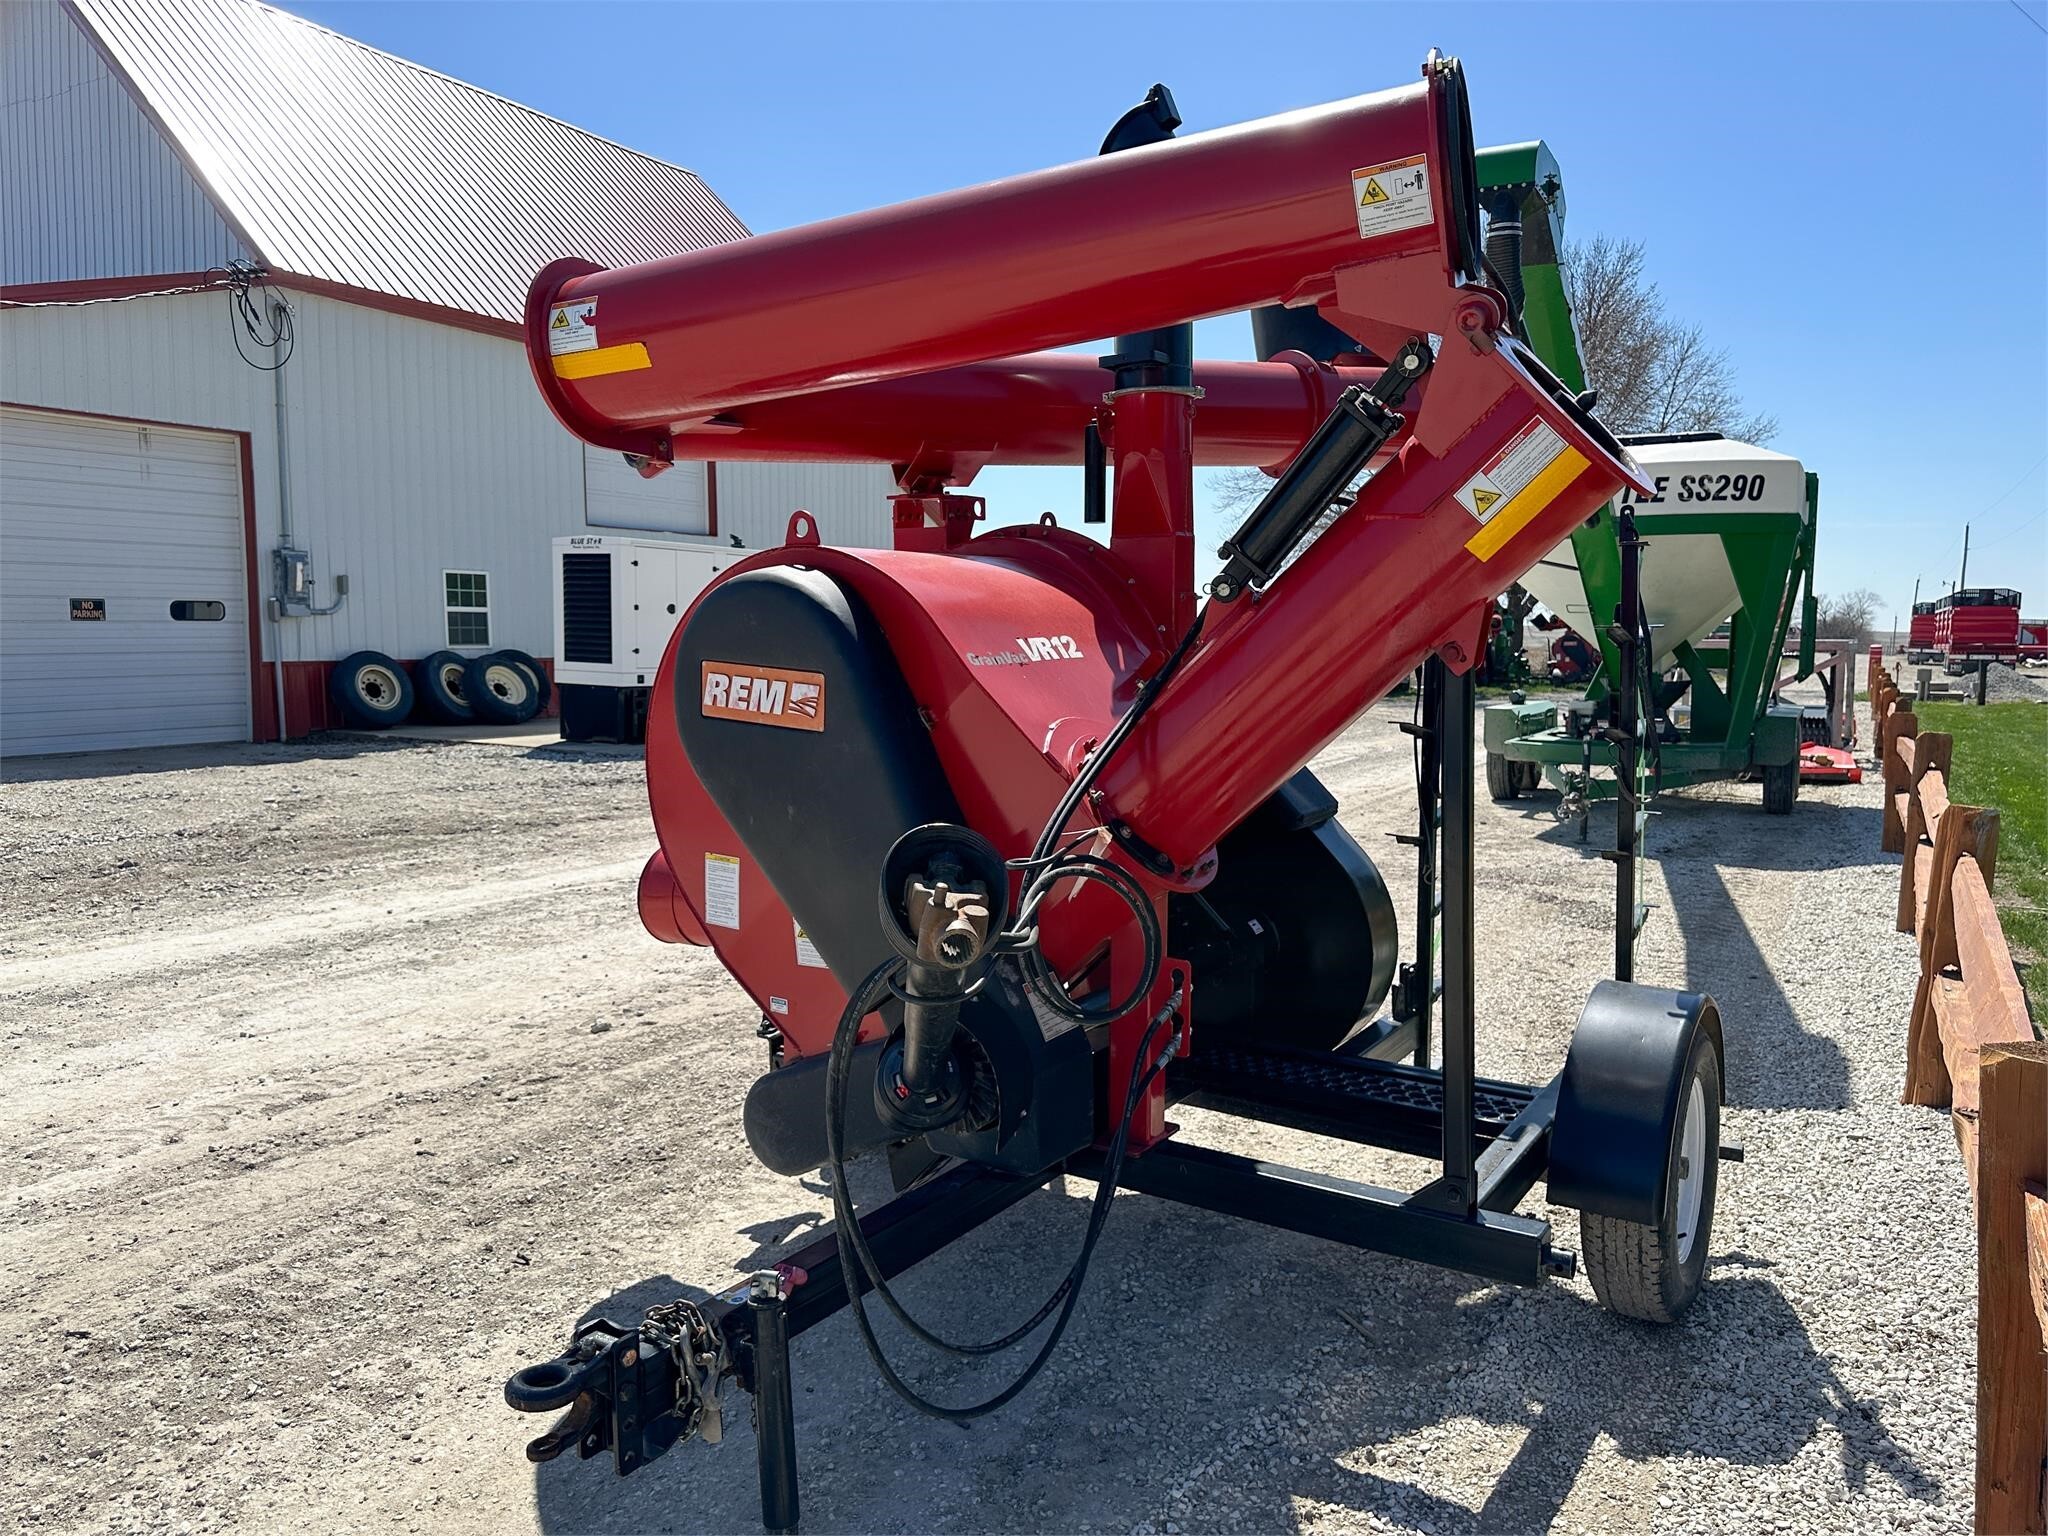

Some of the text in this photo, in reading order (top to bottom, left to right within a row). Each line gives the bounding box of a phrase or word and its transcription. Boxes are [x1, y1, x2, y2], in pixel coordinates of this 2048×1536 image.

[1379, 161, 1407, 172] WARNING
[1504, 434, 1526, 455] DANGER
[1677, 474, 1765, 502] SS290
[570, 537, 585, 545] BLUE
[72, 609, 104, 618] PARKING
[81, 601, 94, 610] NO
[966, 635, 1084, 666] GrainVac VR12
[703, 672, 787, 715] REM
